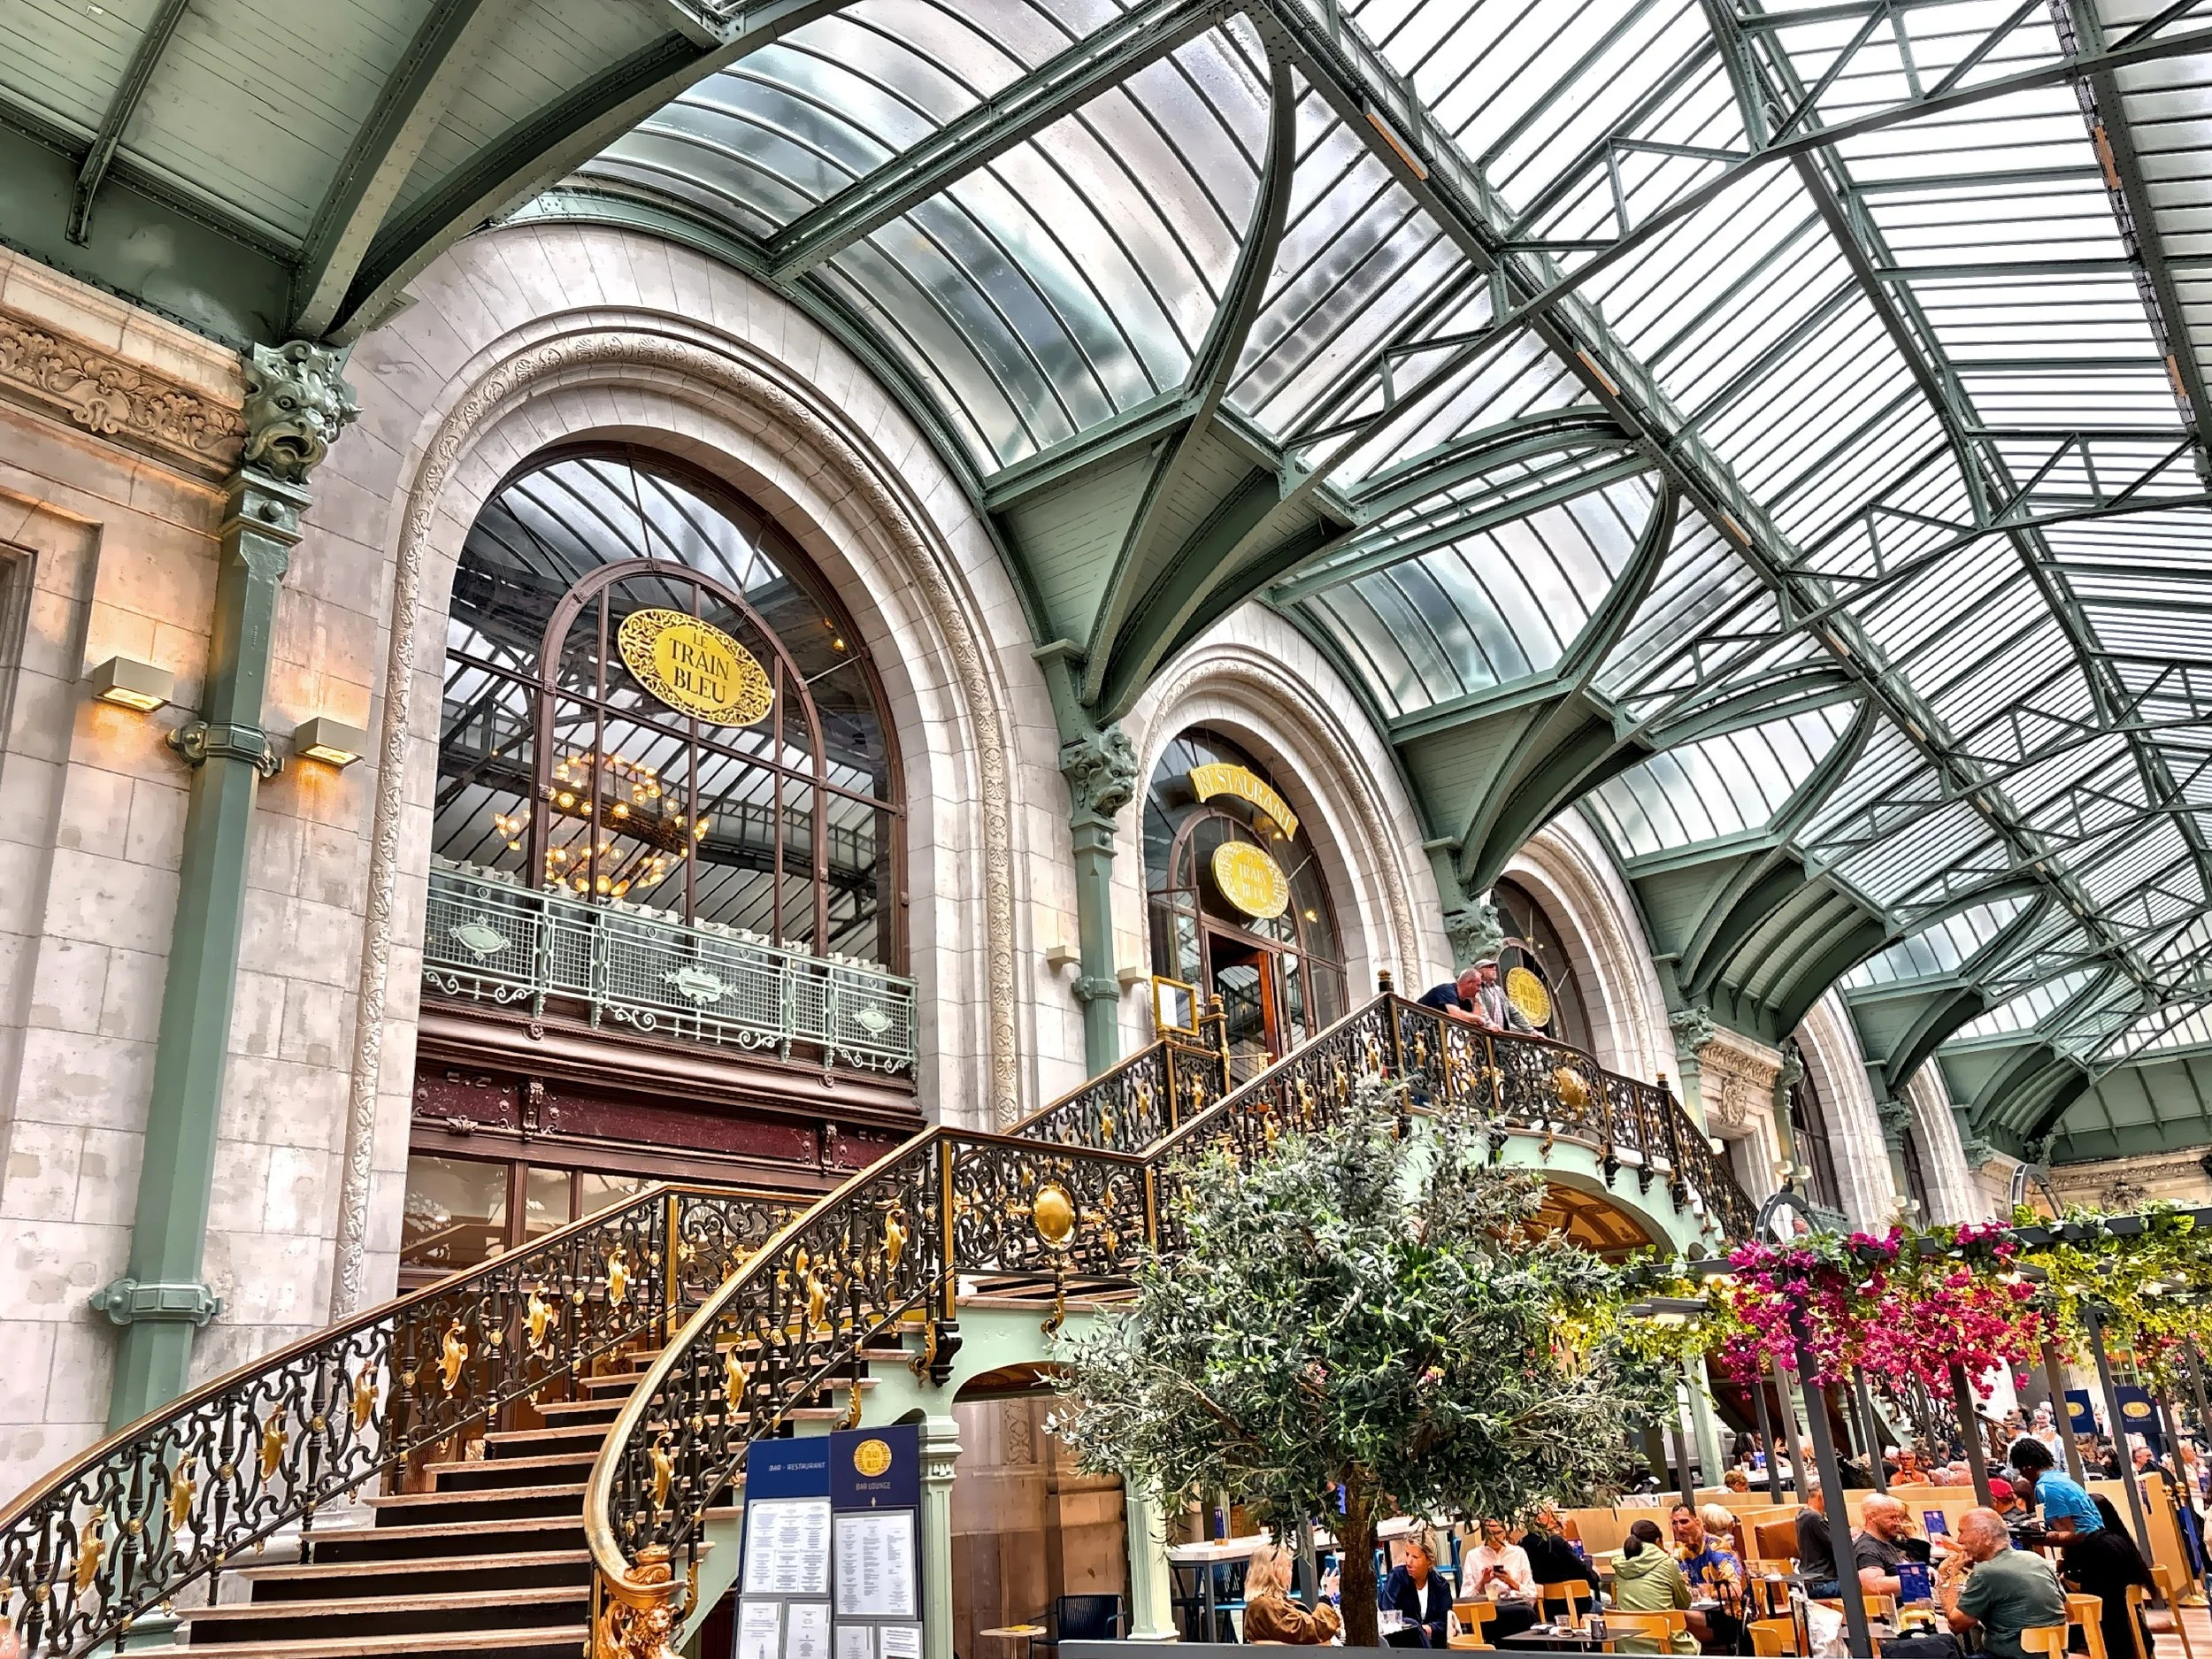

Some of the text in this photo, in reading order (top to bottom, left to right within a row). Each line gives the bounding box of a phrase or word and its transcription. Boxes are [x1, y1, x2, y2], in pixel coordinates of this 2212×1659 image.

[693, 633, 708, 649] LE
[669, 638, 729, 680] TRAIN
[673, 665, 726, 704] BLEU
[1197, 767, 1294, 831] RESTAURANT
[1239, 863, 1268, 886] TRAIN
[1242, 882, 1268, 903] BLEU
[787, 1461, 826, 1471] RESTAURANT
[856, 1481, 892, 1491] BAR LOUNGE
